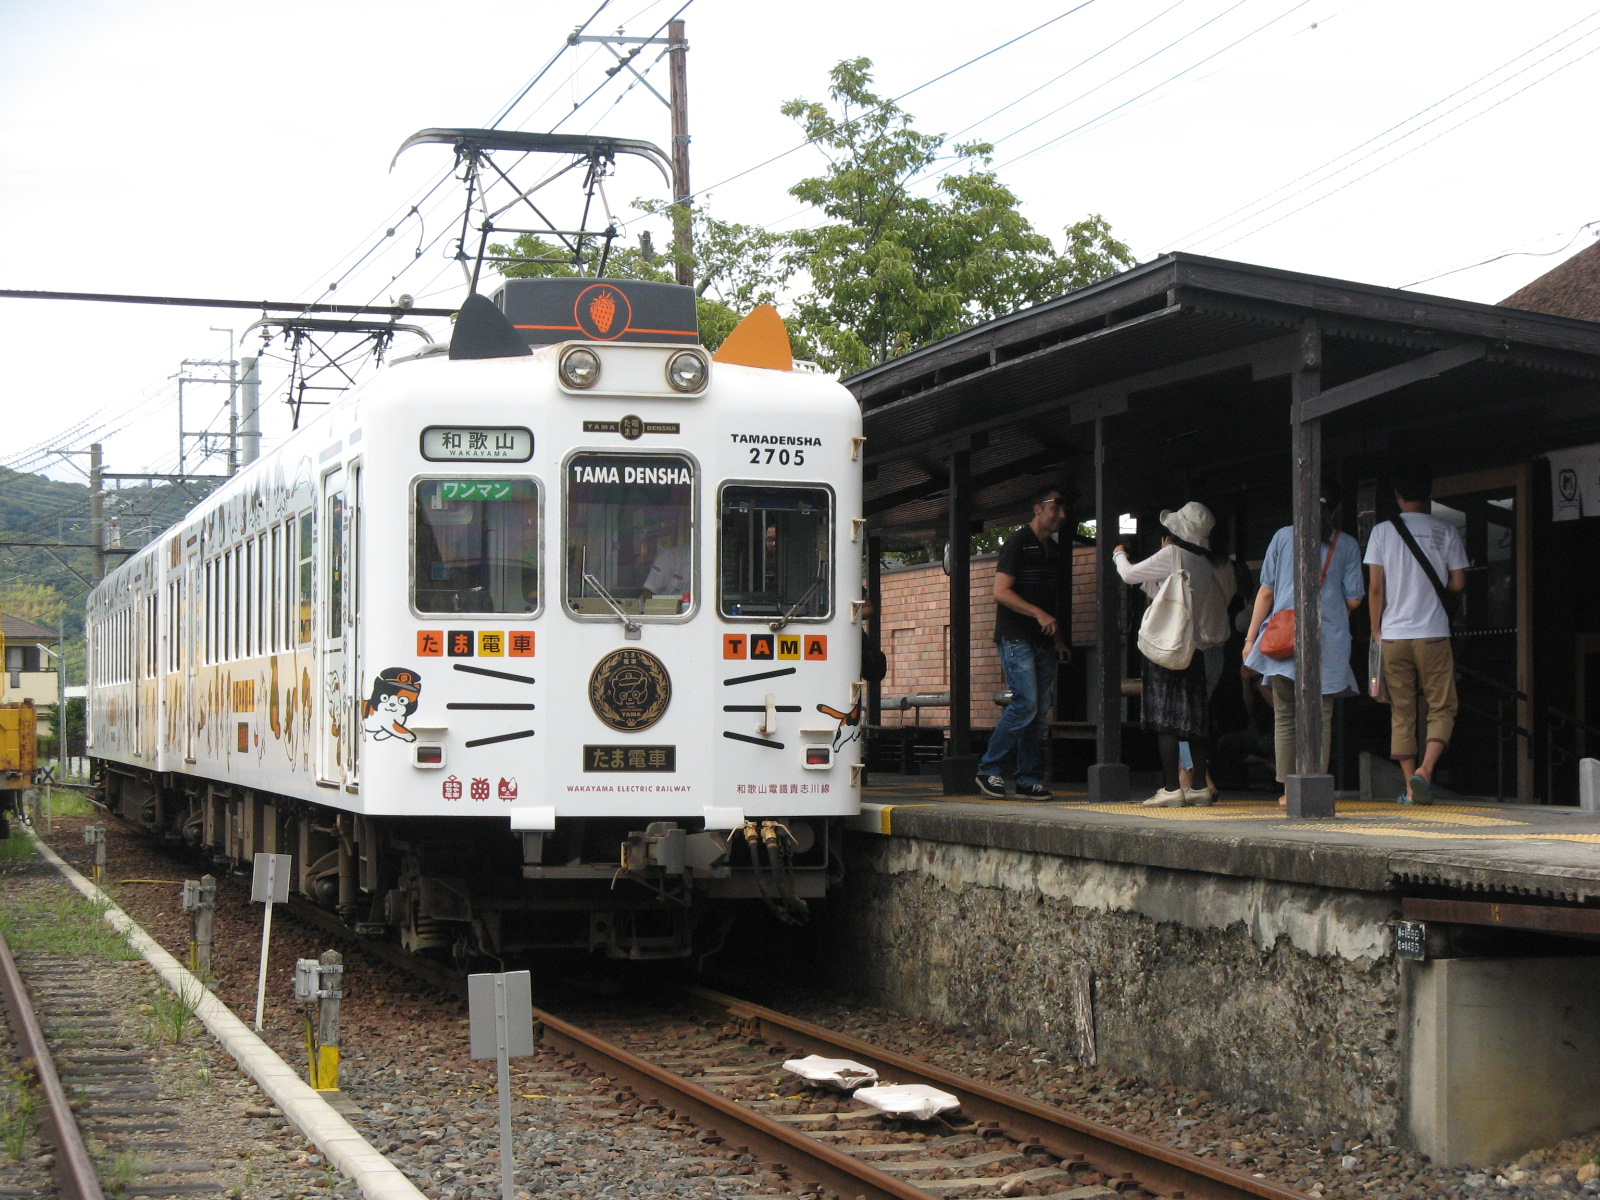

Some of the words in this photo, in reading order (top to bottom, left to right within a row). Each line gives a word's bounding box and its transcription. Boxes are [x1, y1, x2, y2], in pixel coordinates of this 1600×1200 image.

[441, 431, 515, 450] 和歌山
[730, 433, 822, 447] TAMADENSHA
[749, 447, 805, 466] 2705
[574, 466, 620, 484] TAMA
[624, 466, 691, 485] DENSHA
[443, 482, 509, 498] ワンマン
[422, 634, 532, 654] たま電車
[728, 639, 823, 655] TAMA
[592, 748, 667, 769] たま電車
[655, 785, 691, 793] RAILWAY
